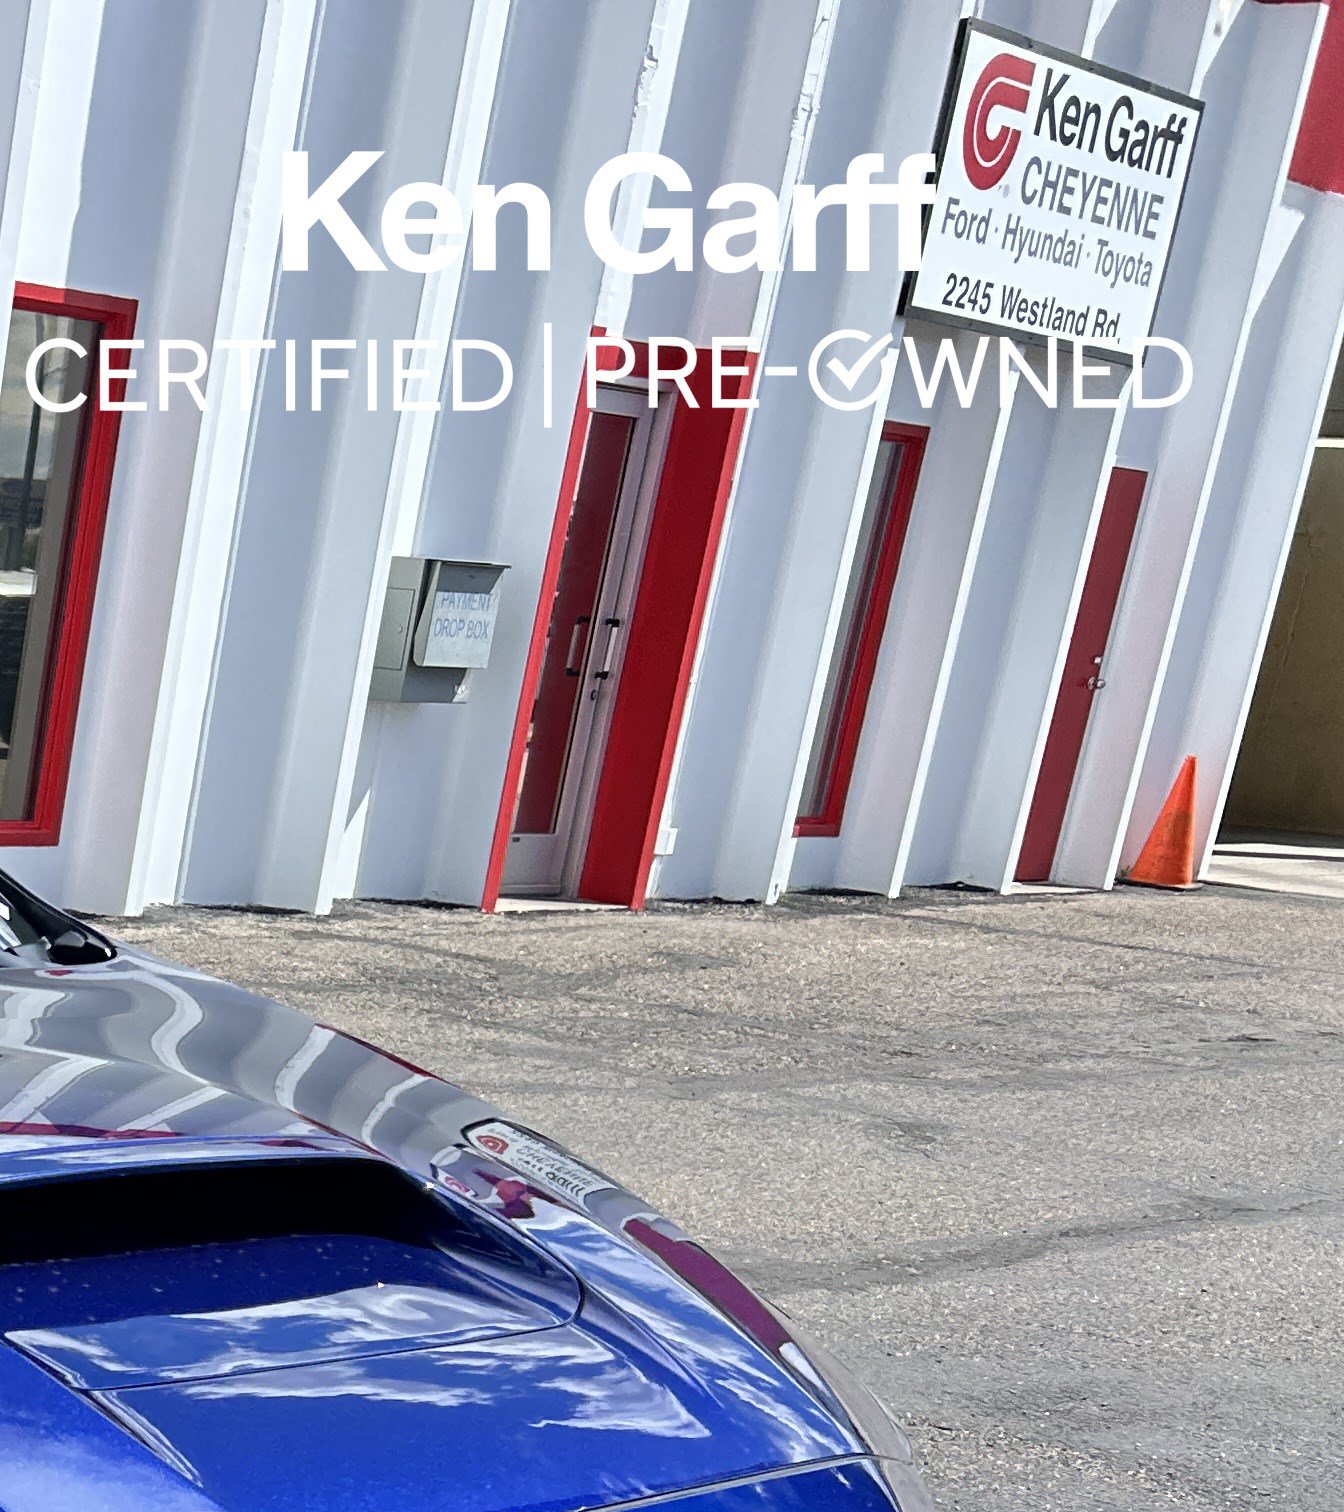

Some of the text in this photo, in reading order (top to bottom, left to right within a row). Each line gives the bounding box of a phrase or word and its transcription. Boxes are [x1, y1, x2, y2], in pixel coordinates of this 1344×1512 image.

[1034, 67, 1189, 180] Ken Garff
[1020, 155, 1165, 241] CHEYENNE
[941, 196, 1153, 289] Ford Hyundai Toyota
[941, 272, 995, 315] 2245
[1000, 284, 1090, 337] Westland
[433, 617, 490, 640] DROP BOX
[441, 593, 493, 611] PAYMENT
